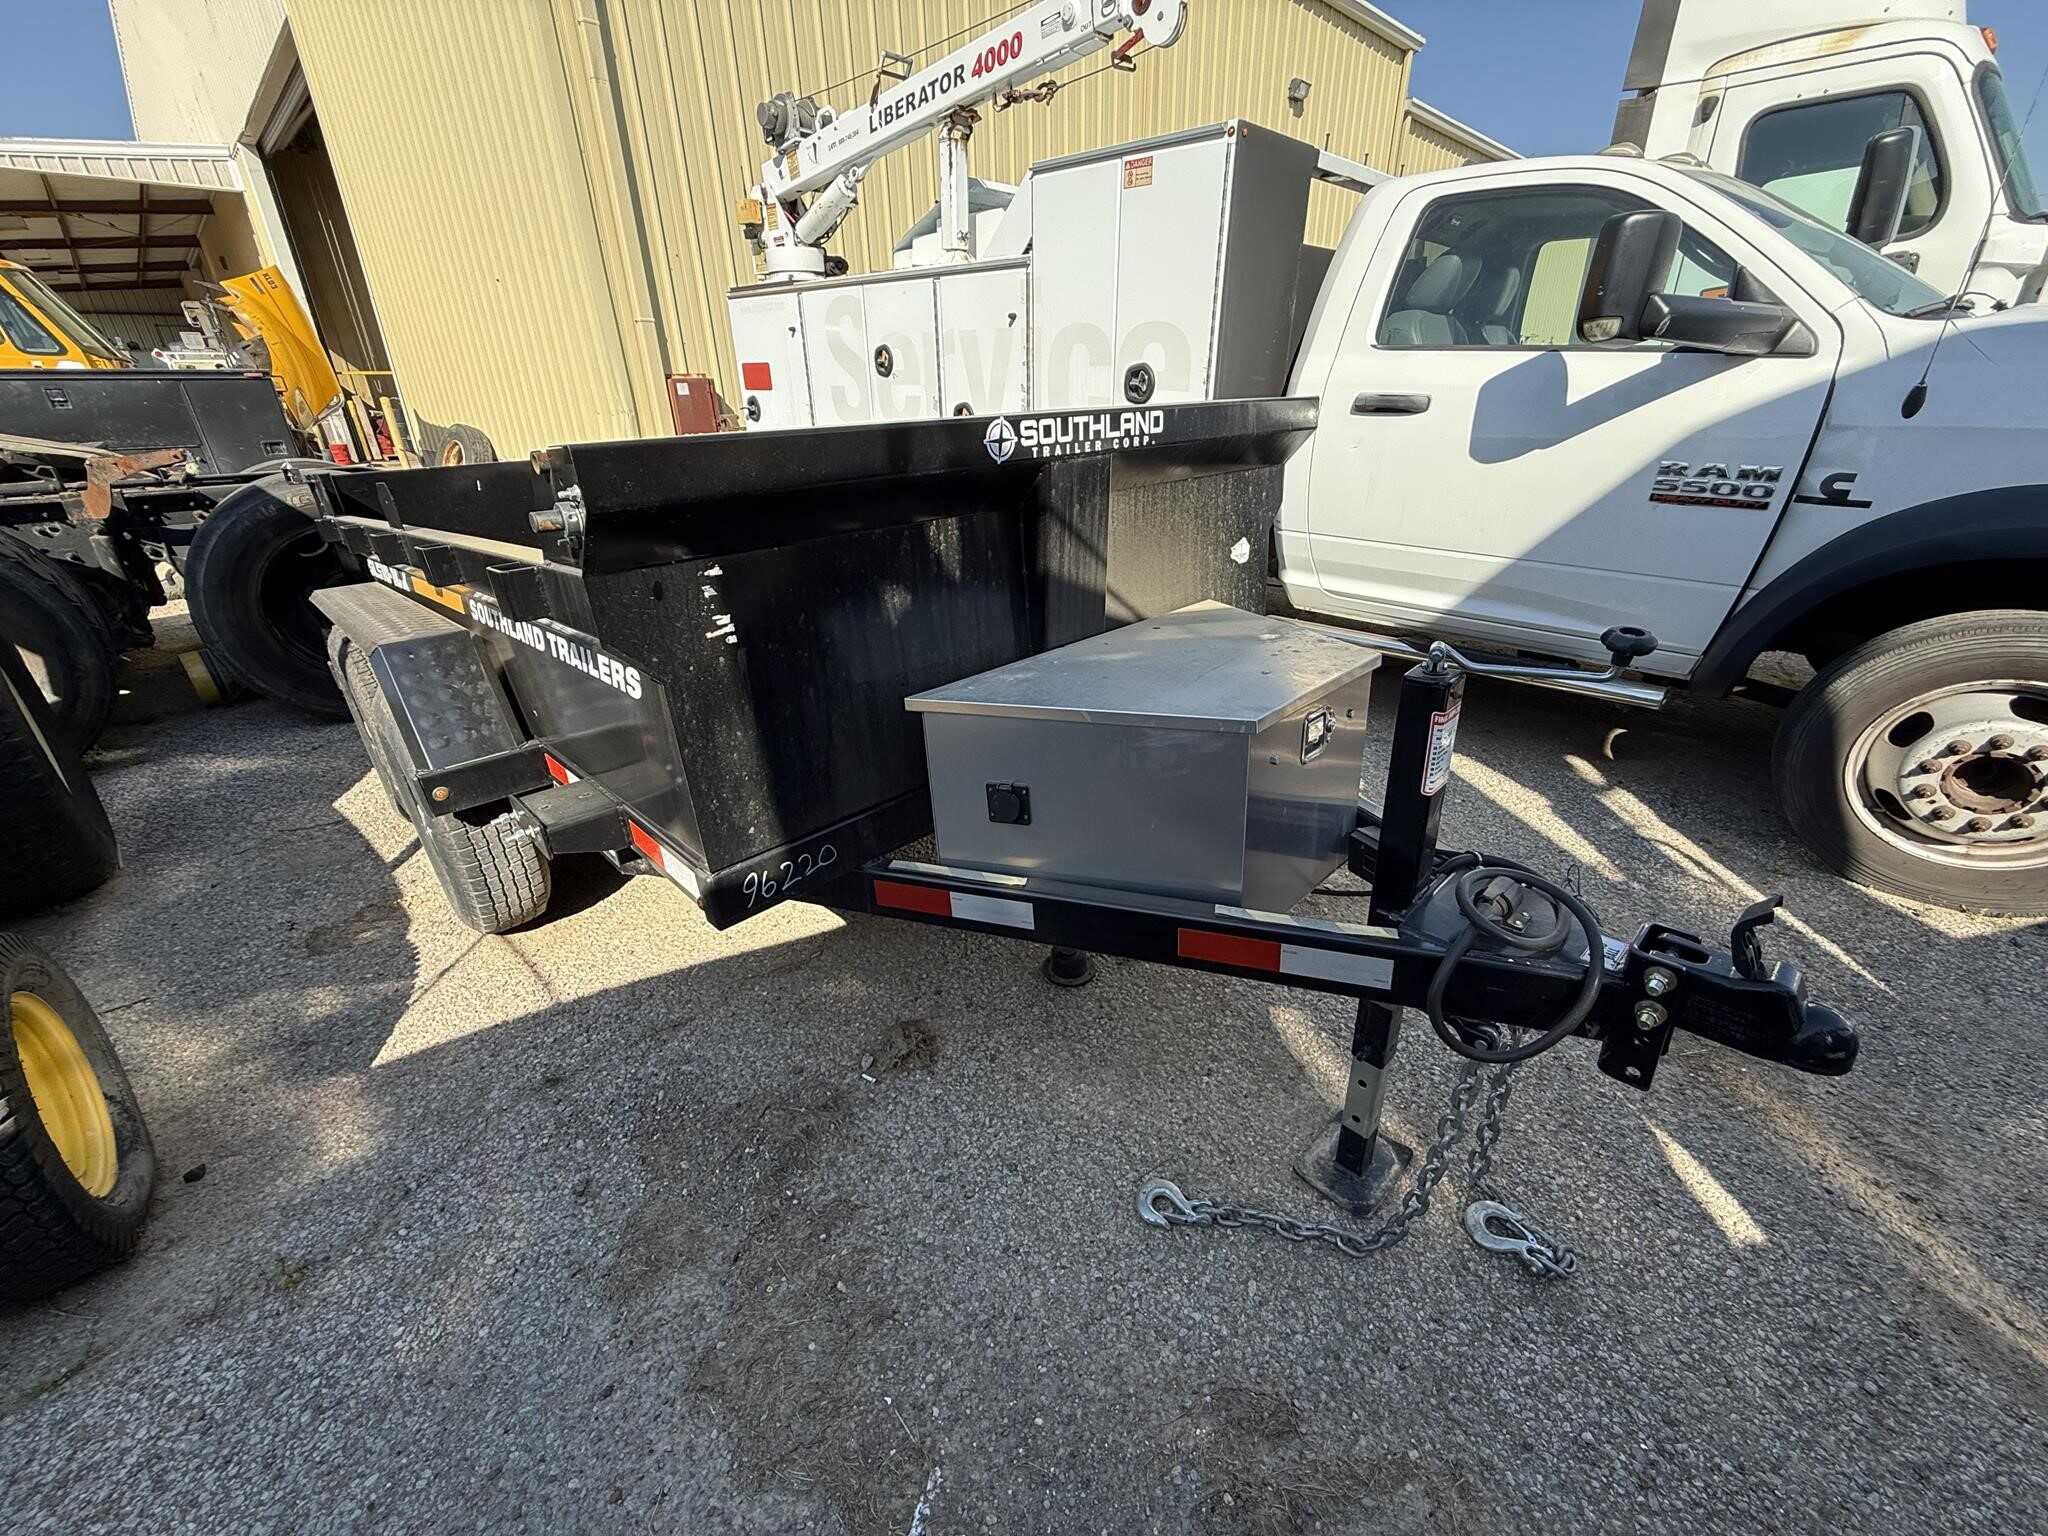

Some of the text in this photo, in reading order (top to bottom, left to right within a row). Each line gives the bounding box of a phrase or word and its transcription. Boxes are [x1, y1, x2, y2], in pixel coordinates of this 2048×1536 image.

[869, 31, 1023, 134] LIBERATOR 4000
[1019, 410, 1164, 447] SOUTHLAND
[1031, 435, 1156, 459] TRAILER CORP.
[1652, 477, 1776, 499] 5500
[1655, 460, 1785, 483] RAM
[469, 598, 643, 700] SOUTHLAND TRAILERS
[743, 844, 838, 908] 96220
